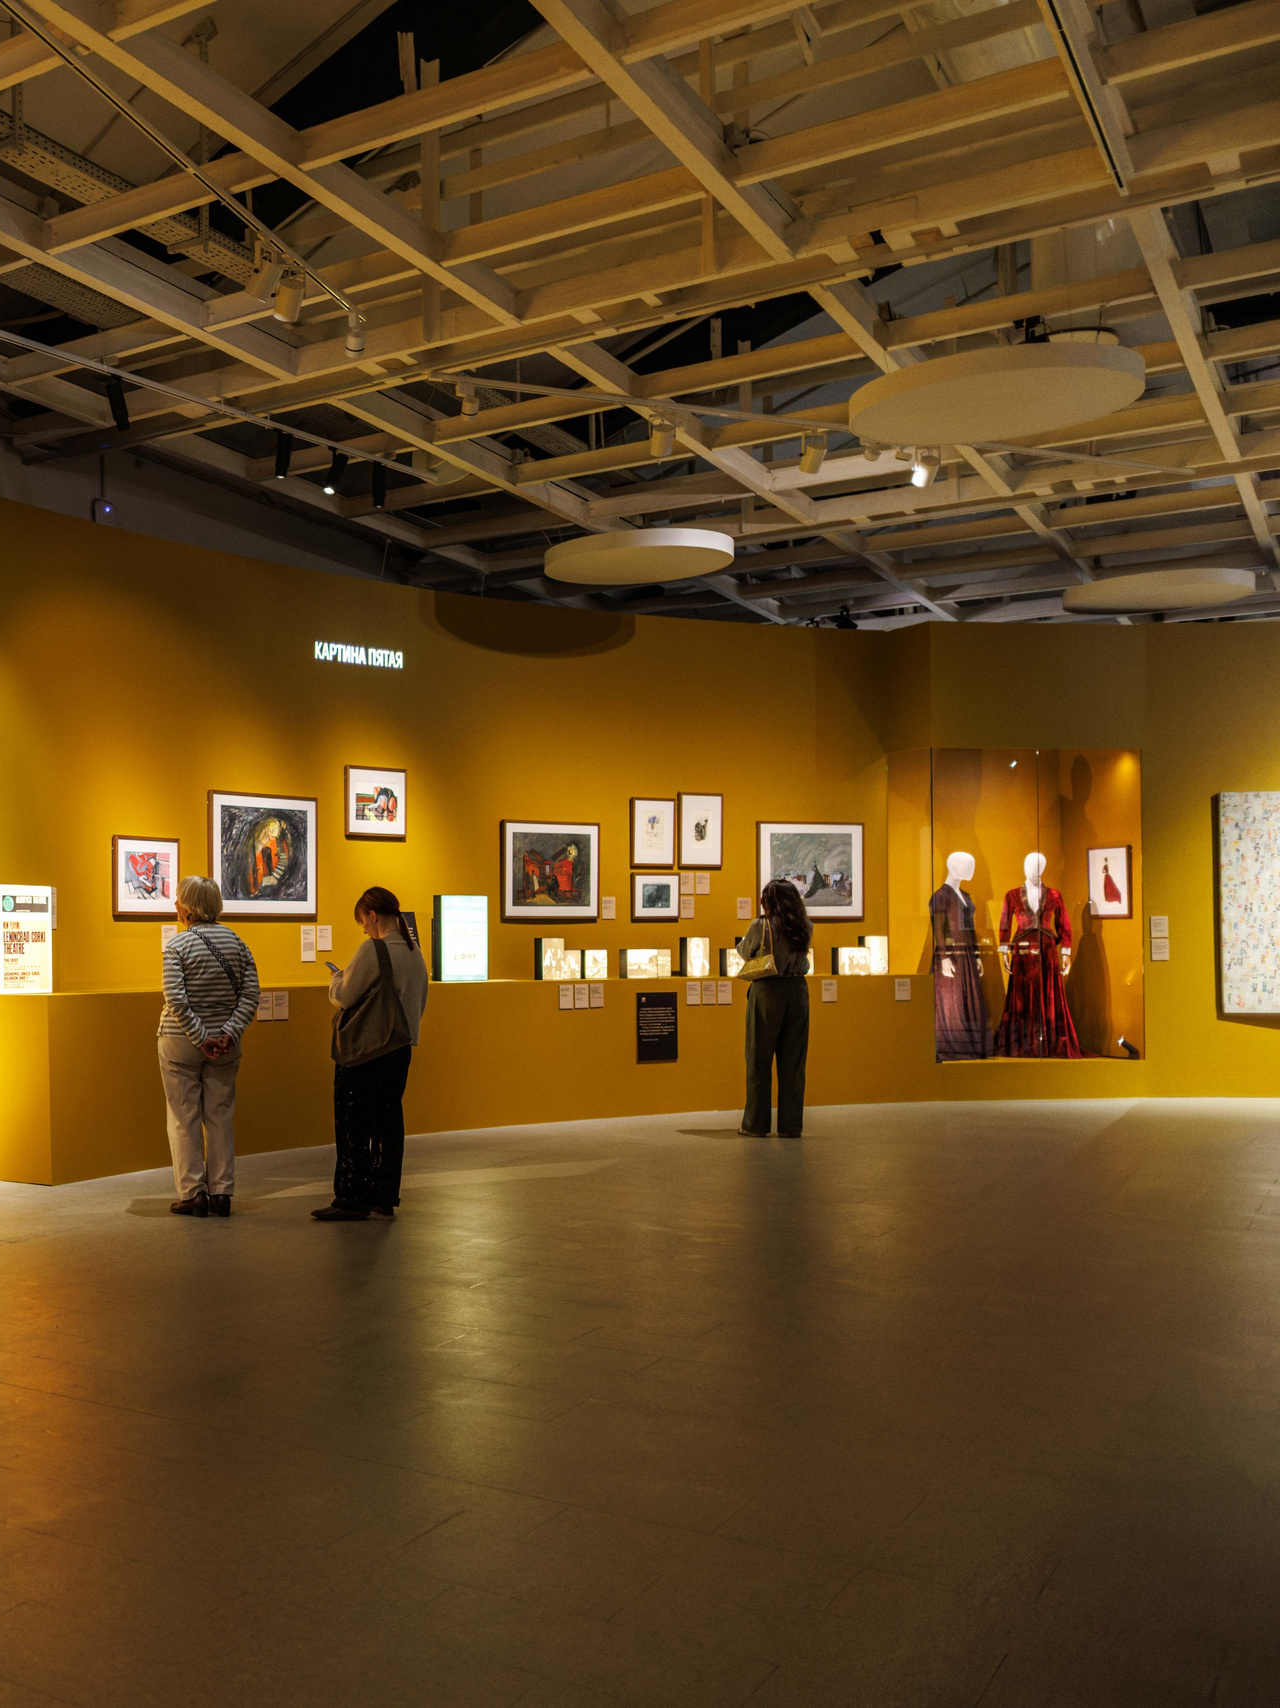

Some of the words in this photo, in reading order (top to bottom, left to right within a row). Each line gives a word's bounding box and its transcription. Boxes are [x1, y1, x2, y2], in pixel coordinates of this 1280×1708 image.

[315, 640, 366, 665] КАРТИНА
[368, 648, 403, 669] ПЯТАЯ
[3, 931, 30, 943] LENINGRAD
[31, 931, 46, 943] GORKI
[3, 943, 25, 955] THEATRE
